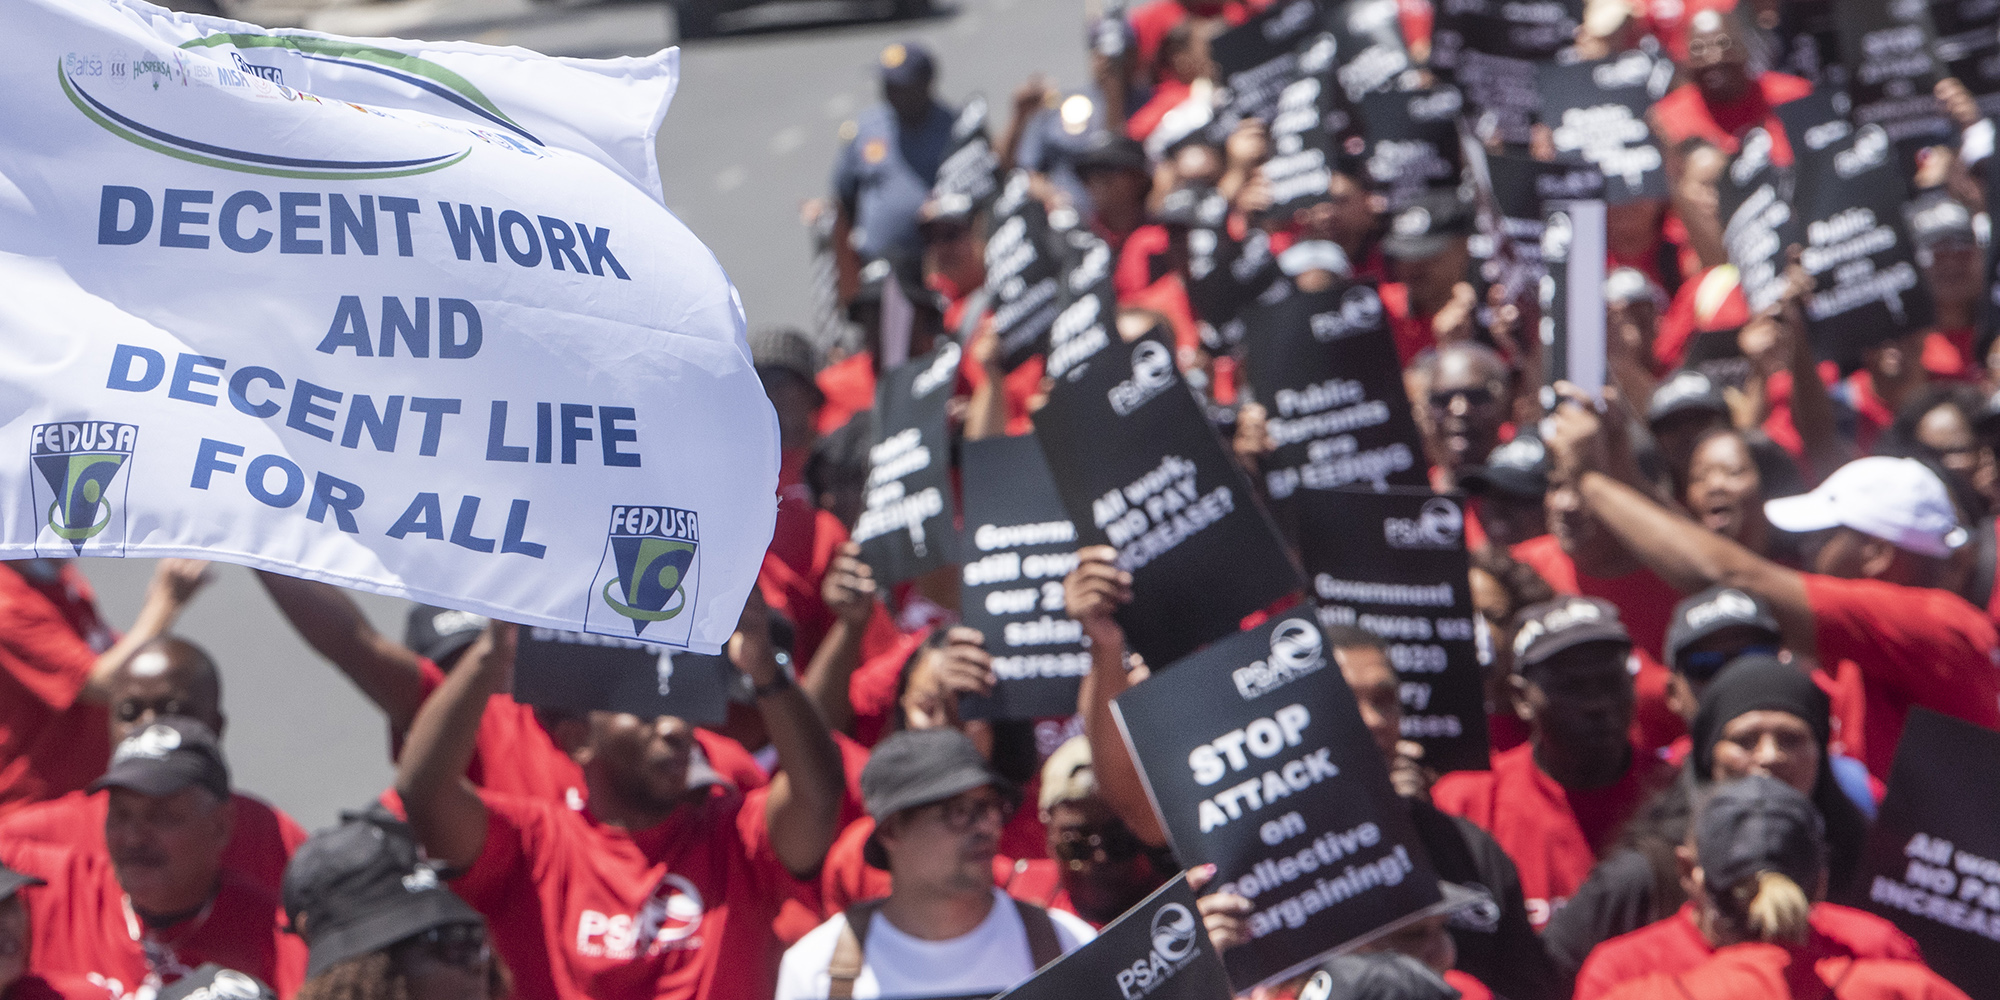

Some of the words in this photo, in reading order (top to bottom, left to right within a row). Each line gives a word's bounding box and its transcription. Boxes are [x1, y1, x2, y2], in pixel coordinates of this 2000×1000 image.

[133, 60, 173, 81] HOSPERSA
[217, 67, 251, 87] MISA
[98, 185, 420, 257] DECENT
[438, 201, 631, 281] WORK
[316, 296, 483, 359] AND
[107, 344, 461, 456] DECENT
[486, 401, 641, 467] LIFE
[31, 421, 137, 454] FEDUSA
[191, 438, 364, 533] FOR
[385, 493, 546, 559] ALL
[1093, 488, 1128, 530] All
[1106, 508, 1149, 548] NO
[1146, 477, 1198, 524] PAY
[610, 506, 699, 541] FEDUSA
[1116, 486, 1235, 573] NCREASE?
[985, 588, 1039, 616] our
[1315, 573, 1455, 607] Government
[1004, 615, 1092, 648] salar
[1358, 614, 1433, 640] owes
[1435, 617, 1474, 640] us
[991, 652, 1092, 680] ncreas
[1233, 655, 1294, 699] PSA
[1390, 643, 1448, 673] 020
[1188, 703, 1311, 786] STOP
[1198, 747, 1340, 834] ATTACK
[1260, 811, 1306, 846] on
[1904, 832, 1954, 866] All
[1249, 844, 1413, 938] argaining!
[1906, 860, 1957, 895] NO
[1960, 877, 2000, 911] PA
[1870, 875, 2000, 942] INCREAS
[1116, 950, 1173, 1000] PSA
